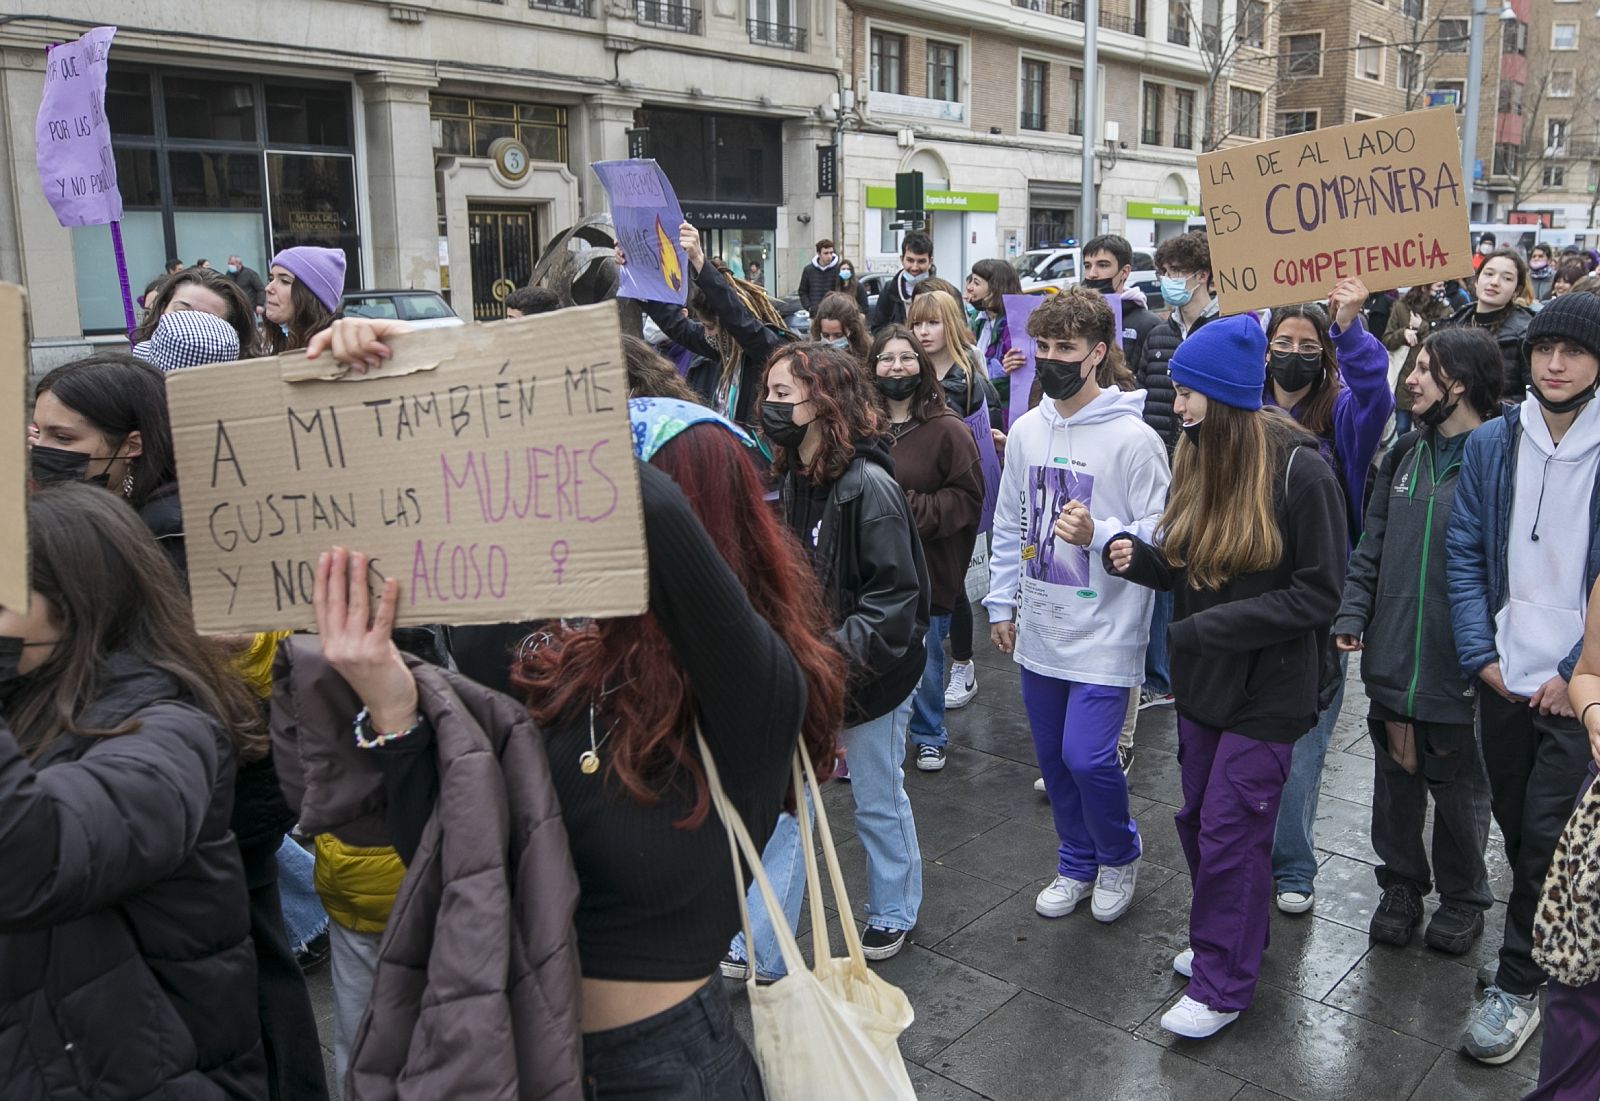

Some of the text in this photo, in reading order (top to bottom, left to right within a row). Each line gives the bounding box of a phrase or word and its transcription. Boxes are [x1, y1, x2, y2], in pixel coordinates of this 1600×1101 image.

[61, 56, 80, 81] QUE
[48, 115, 91, 141] POR LAS
[509, 152, 520, 169] 3
[1209, 127, 1416, 185] LA DE AL LADO
[56, 178, 65, 198] Y
[71, 176, 87, 197] NO
[1210, 161, 1459, 235] ES COMPAÑERA
[699, 212, 747, 220] SARABIA
[1219, 266, 1257, 294] NO
[211, 360, 615, 488] A MI TAMBIÉN ME
[209, 439, 619, 552] GUSTAN LAS MUJERES
[217, 565, 243, 615] Y
[271, 559, 314, 612] NO
[410, 539, 508, 606] ACOSO
